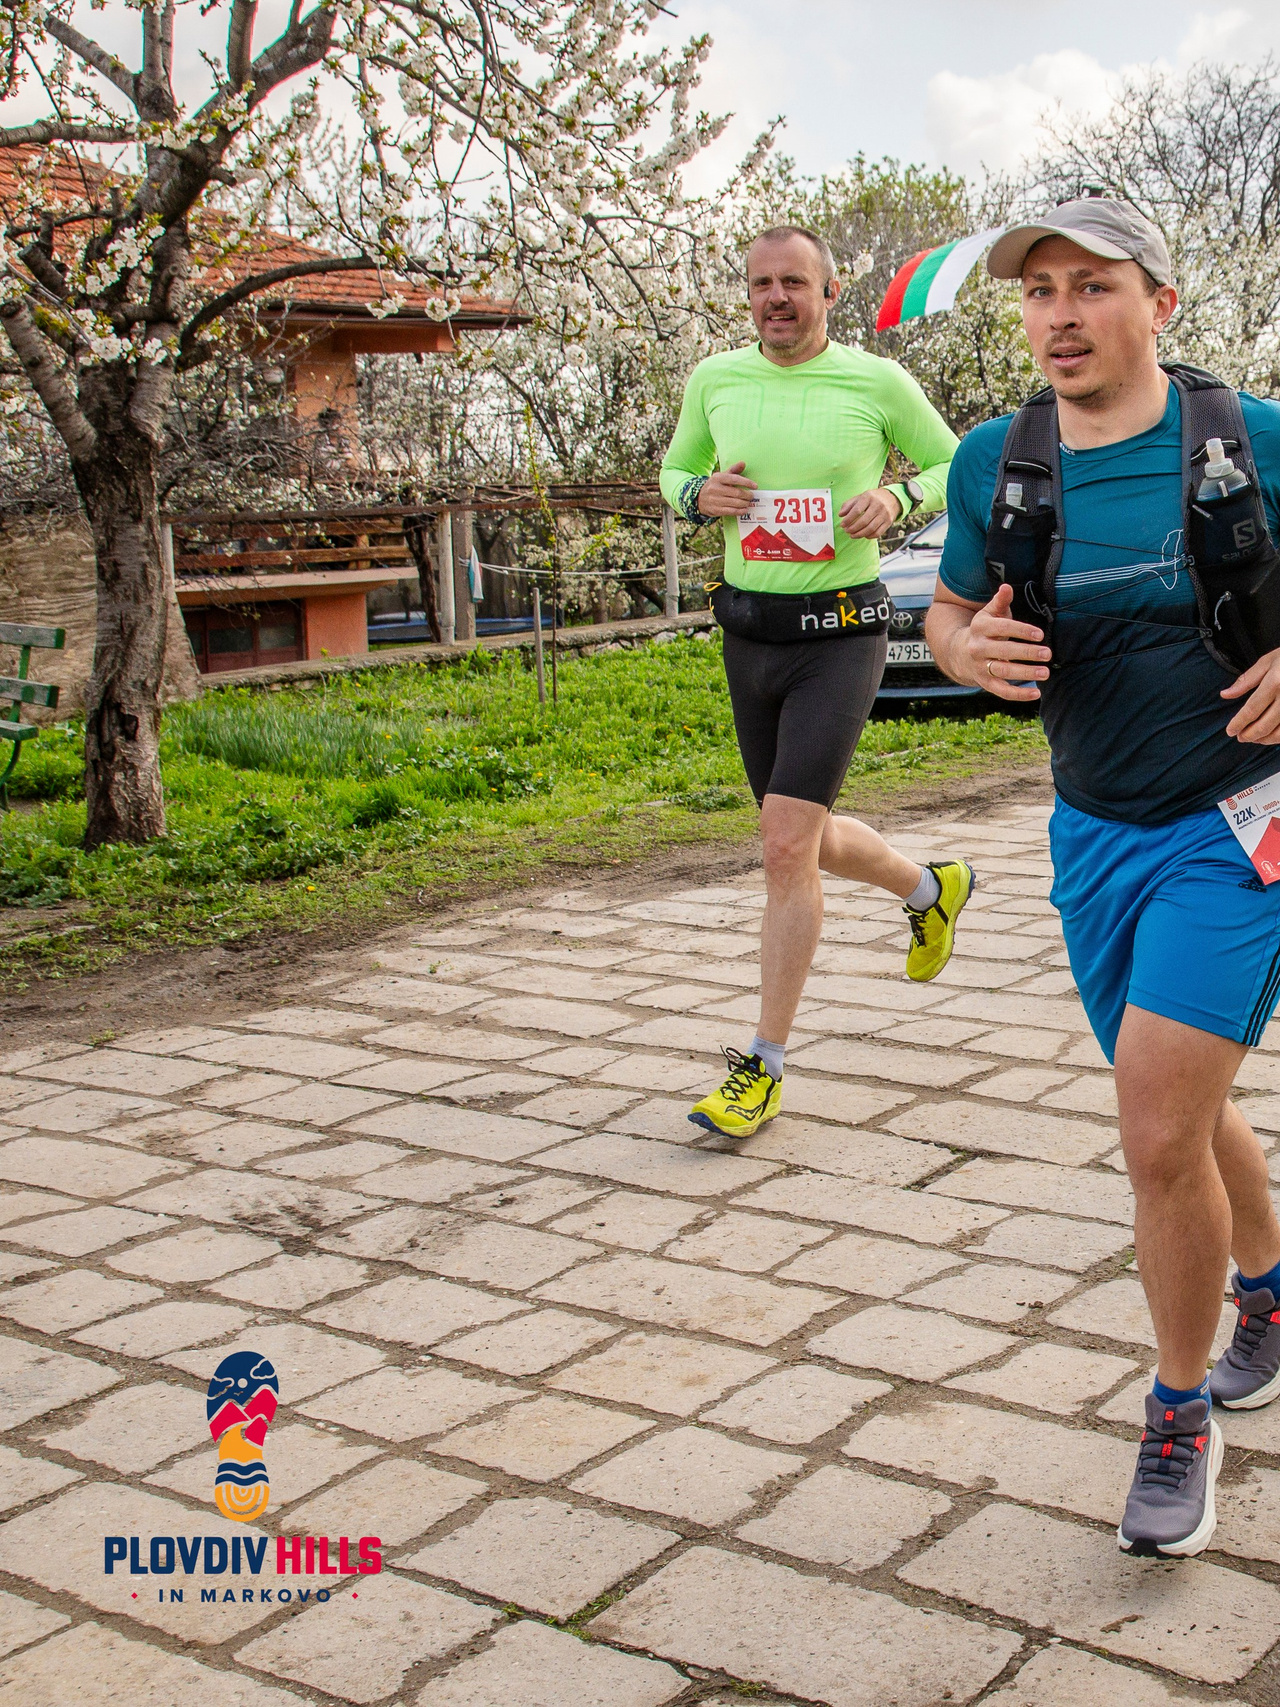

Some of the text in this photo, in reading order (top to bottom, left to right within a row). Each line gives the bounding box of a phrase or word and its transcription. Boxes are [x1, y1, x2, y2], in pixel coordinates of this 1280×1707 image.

[774, 497, 827, 524] 2313
[801, 597, 890, 631] naked
[888, 644, 921, 661] 4795
[1236, 787, 1255, 801] HILLS
[1233, 806, 1256, 825] 22K
[1238, 880, 1267, 893] adidas
